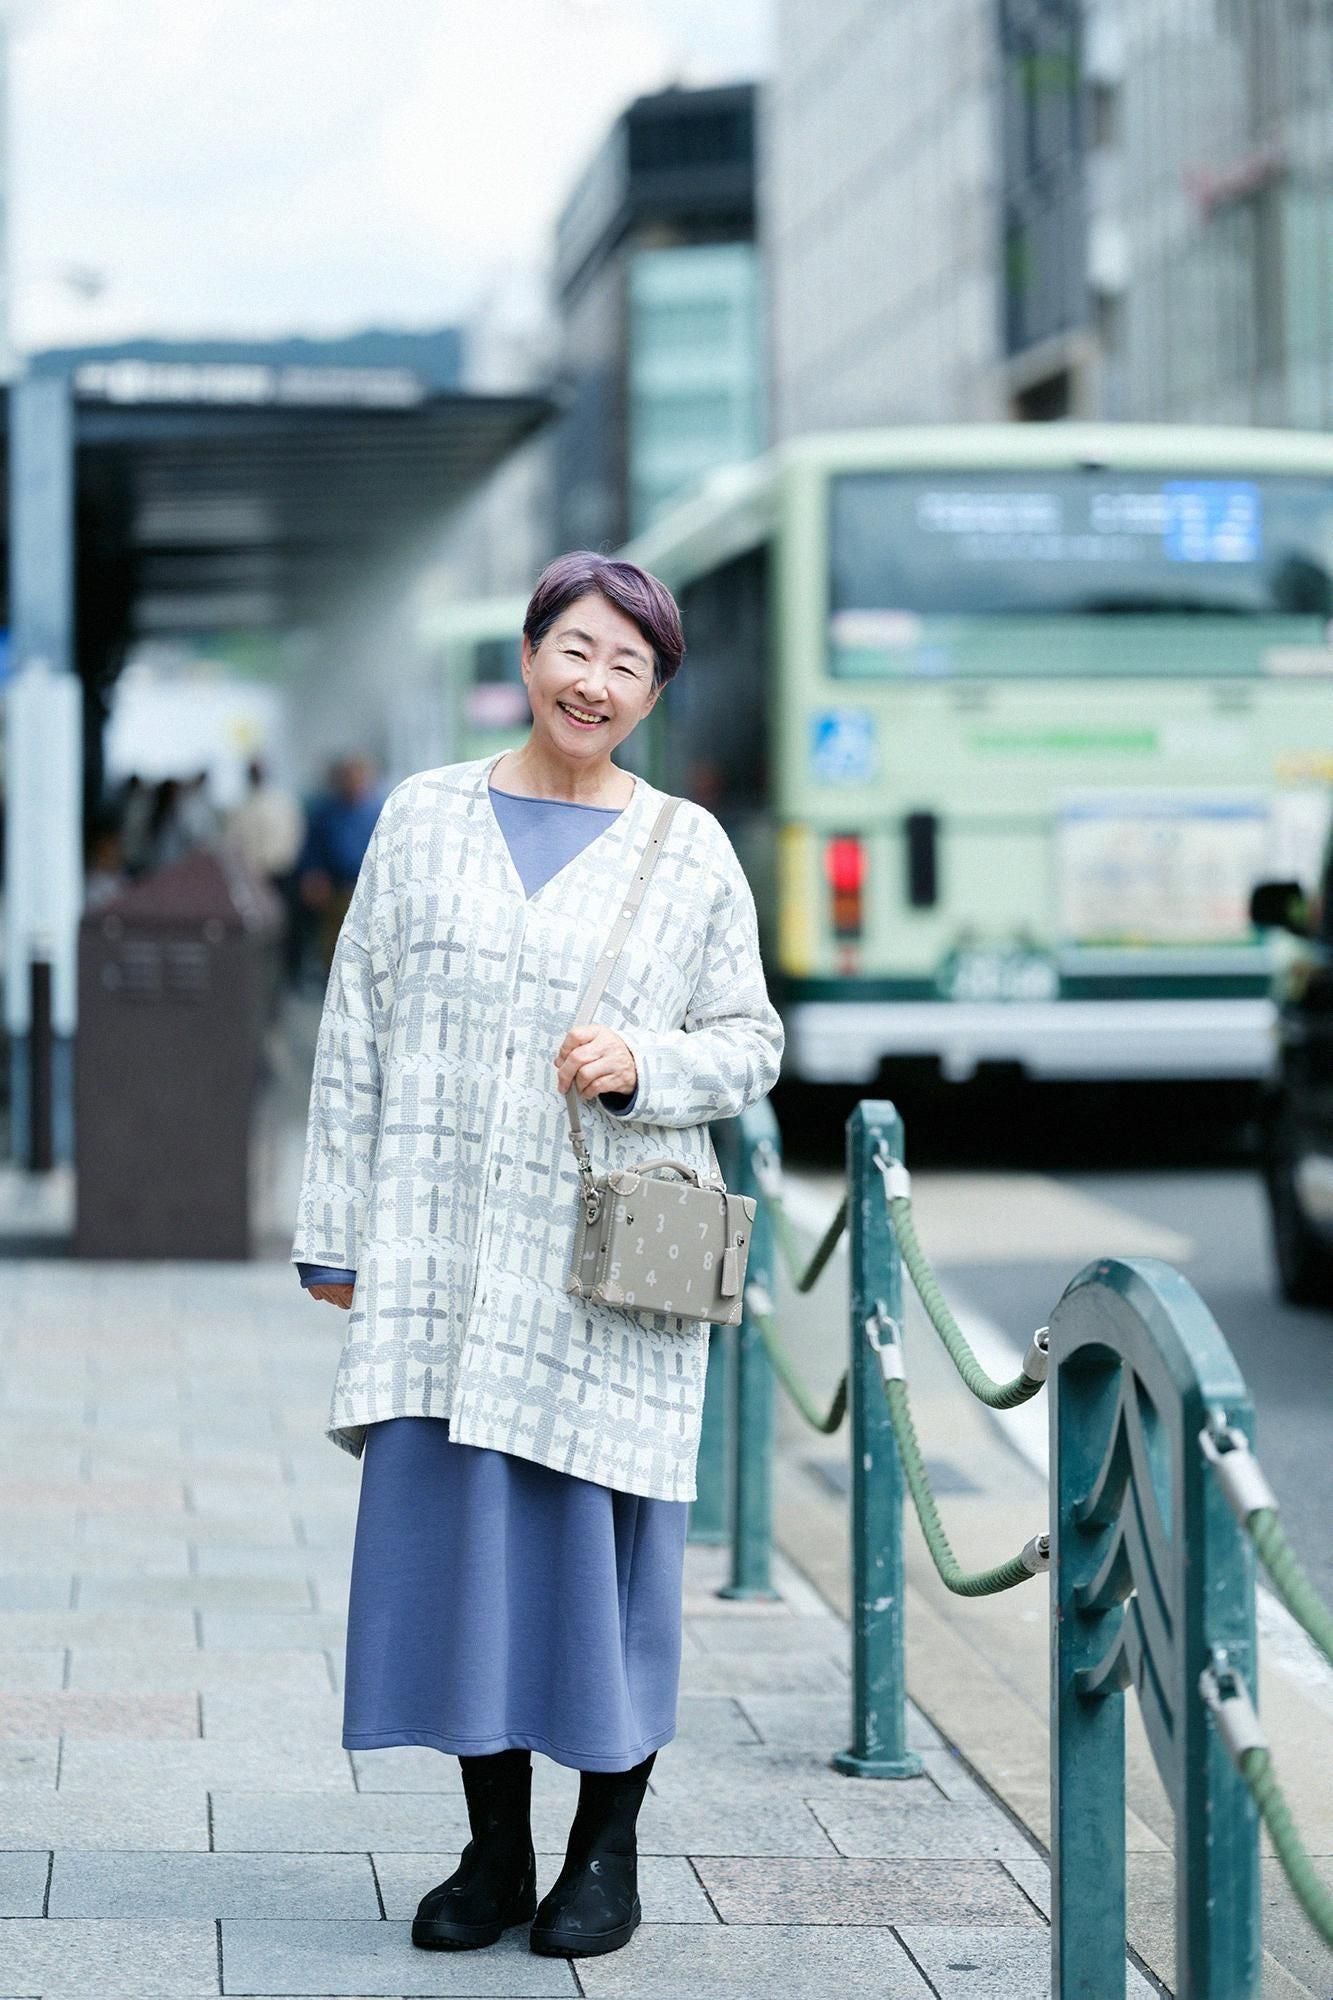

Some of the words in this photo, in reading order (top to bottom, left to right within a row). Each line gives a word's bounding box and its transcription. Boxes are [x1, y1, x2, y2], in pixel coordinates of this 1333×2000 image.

[678, 1187, 688, 1205] 2
[615, 1204, 627, 1222] 9
[655, 1214, 665, 1233] 3
[699, 1223, 709, 1240] 7
[635, 1238, 644, 1255] 2
[668, 1245, 679, 1260] 0
[703, 1251, 713, 1270] 8
[610, 1262, 621, 1280] 5
[646, 1270, 657, 1287] 4
